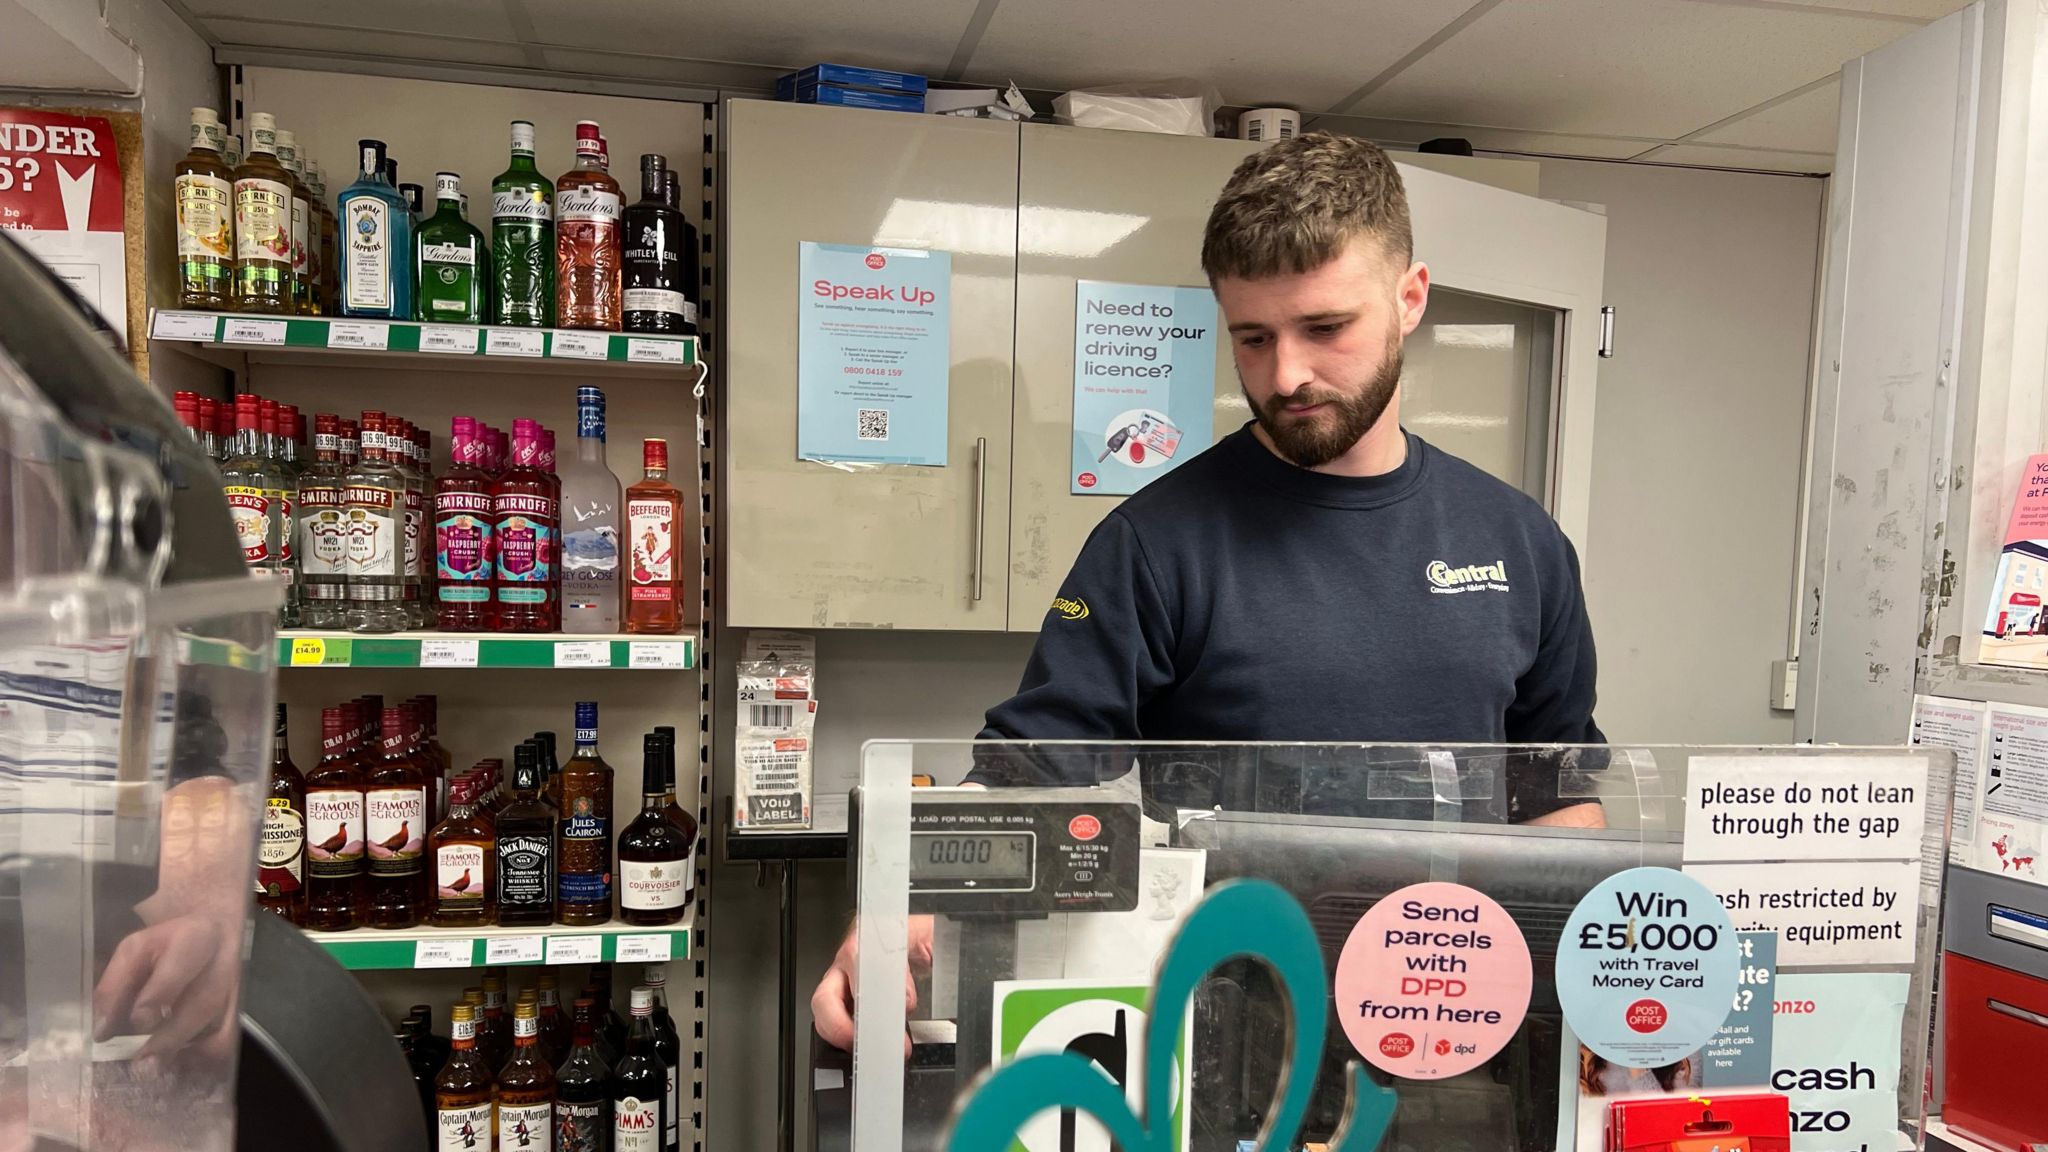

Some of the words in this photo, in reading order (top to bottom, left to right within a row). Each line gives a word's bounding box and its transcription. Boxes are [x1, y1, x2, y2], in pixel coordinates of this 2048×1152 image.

[353, 204, 380, 216] BOMBAY
[560, 194, 614, 215] Gordon's
[4, 207, 20, 218] be
[352, 242, 383, 252] SAPPHIRE
[426, 246, 472, 262] Gordon's
[625, 250, 657, 258] WHITLEY
[658, 250, 678, 261] EILL
[814, 280, 895, 301] Speak
[901, 286, 936, 306] Up
[1086, 299, 1145, 316] Need
[1150, 304, 1173, 318] to
[1086, 323, 1153, 337] renew
[1158, 327, 1206, 341] your
[1085, 341, 1157, 361] driving
[844, 366, 864, 374] 0800
[1084, 361, 1173, 378] licence?
[362, 432, 383, 444] £16.99
[301, 491, 344, 504] SMIRNO
[346, 489, 388, 505] IRNOFF
[2027, 488, 2040, 497] at
[230, 496, 262, 508] LEN'S
[437, 496, 490, 510] SMIRNOFF
[495, 497, 546, 512] SMIRNOFF
[630, 504, 670, 518] BEEFEATER
[448, 540, 481, 548] RASPBERRY
[503, 541, 535, 550] RASPBERRY
[1427, 560, 1508, 586] Central
[740, 693, 755, 701] 24
[577, 730, 598, 739] £17.99
[1701, 782, 1775, 809] please
[1784, 782, 1812, 803] do
[1821, 783, 1859, 803] not
[1867, 781, 1914, 804] lean
[314, 801, 360, 812] FAMOUS
[377, 799, 420, 811] FAMOUS
[759, 799, 791, 808] VOID
[314, 810, 360, 820] GROUSE
[376, 808, 420, 819] GROUSE
[755, 810, 795, 820] LABEL
[572, 818, 595, 829] JULES
[1025, 816, 1034, 824] kg
[1712, 812, 1803, 839] through
[1813, 812, 1850, 834] the
[1859, 816, 1900, 838] gap
[565, 827, 602, 837] CLAIRON
[263, 848, 284, 858] 1856
[499, 842, 519, 857] JACK
[519, 838, 549, 856] DANIEL'S
[929, 839, 991, 864] 0.000
[1100, 845, 1109, 853] kg
[446, 853, 480, 861] FAMOUS
[629, 880, 680, 890] COURVOISIER
[1053, 890, 1072, 899] Avery
[1760, 887, 1863, 908] restricted
[1872, 886, 1897, 911] by
[1615, 891, 1687, 917] Win
[1402, 901, 1479, 922] Send
[1786, 920, 1903, 945] equipment
[1384, 929, 1492, 949] parcels
[1405, 954, 1467, 973] with
[1600, 958, 1638, 970] with
[1643, 958, 1699, 971] Travel
[1400, 977, 1467, 997] DPD
[1592, 975, 1655, 990] Money
[1660, 975, 1704, 988] Card
[1359, 1000, 1429, 1021] from
[1436, 1004, 1502, 1024] here
[1635, 1006, 1660, 1015] POST
[1629, 1015, 1662, 1025] OFFICE
[1734, 1025, 1749, 1033] and
[1718, 1036, 1732, 1046] gift
[1733, 1036, 1754, 1045] cards
[1382, 1044, 1410, 1052] OFFICE
[1454, 1043, 1476, 1056] dpd
[1707, 1048, 1742, 1056] available
[1715, 1059, 1734, 1067] here
[1771, 1061, 1875, 1091] cash
[522, 1108, 550, 1121] Morgan
[572, 1105, 599, 1118] Morgan
[440, 1112, 467, 1127] Captain
[613, 1110, 655, 1128] PIMM'S
